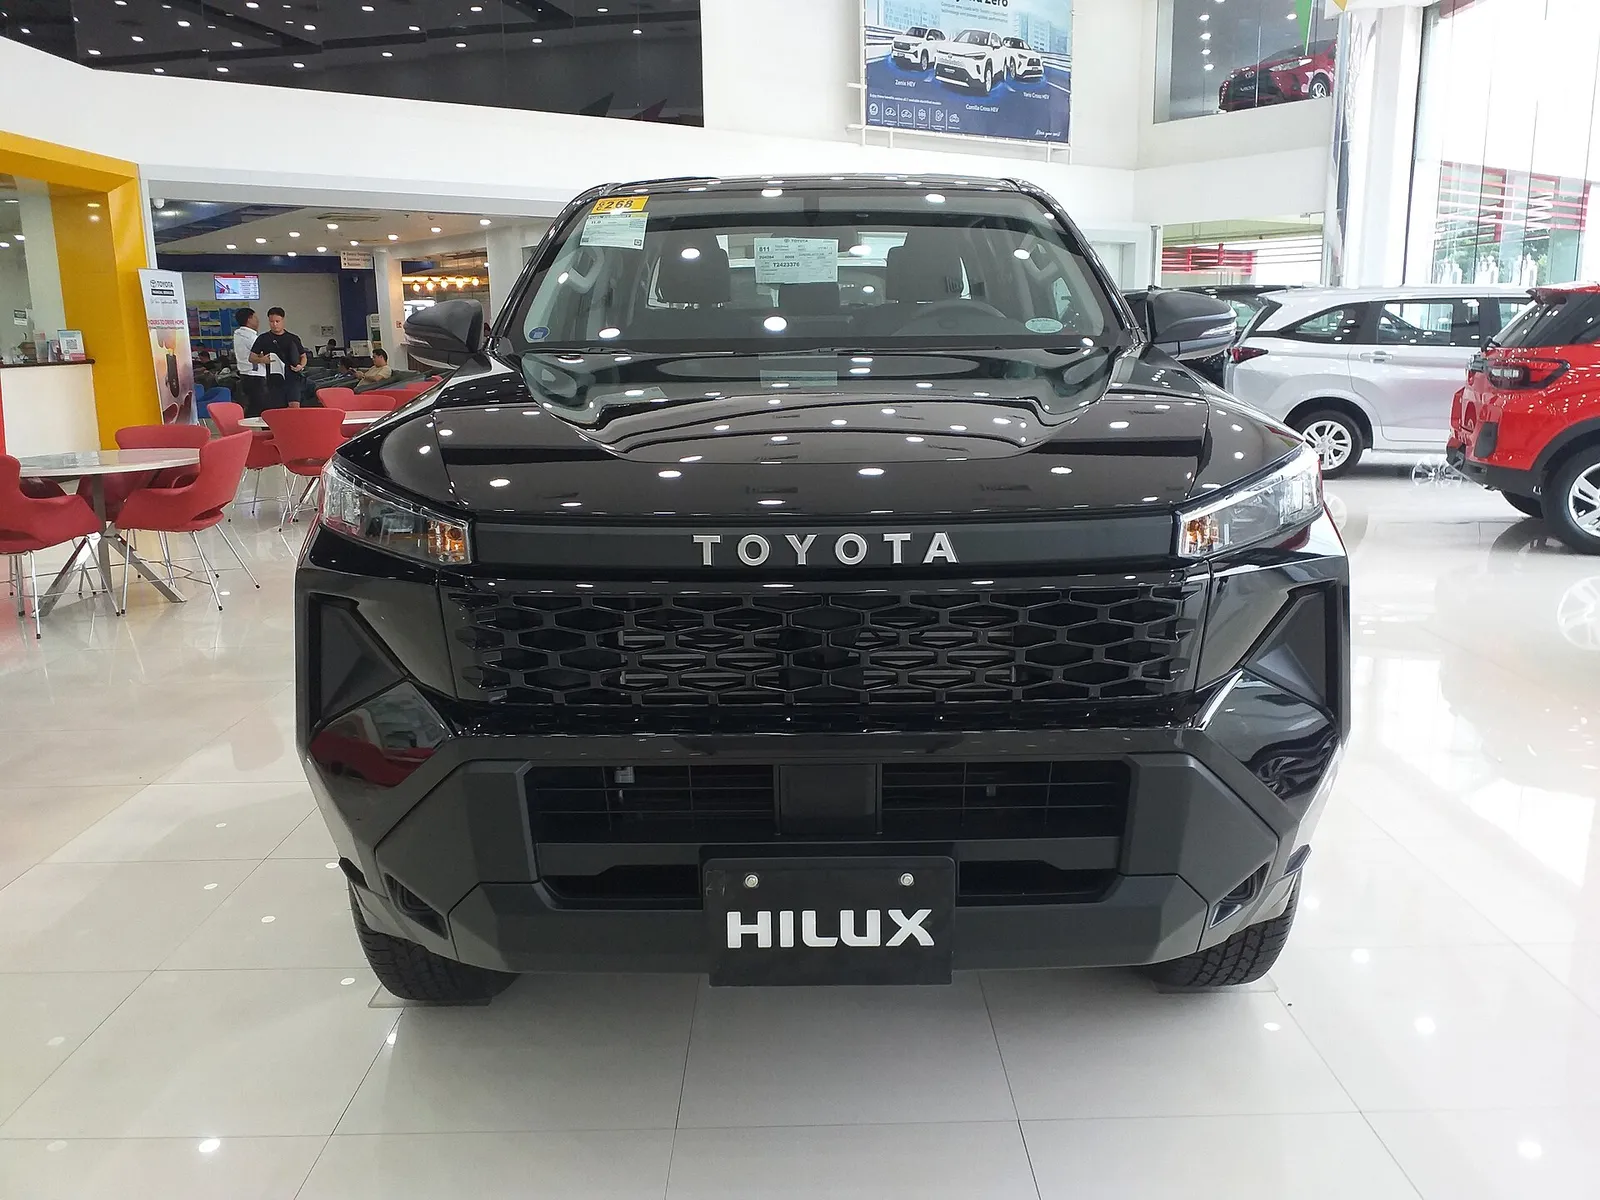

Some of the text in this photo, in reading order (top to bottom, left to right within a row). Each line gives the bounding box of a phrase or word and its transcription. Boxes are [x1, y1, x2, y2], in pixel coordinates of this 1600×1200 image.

[156, 281, 174, 289] TOYOTA
[692, 532, 960, 567] TOYOTA
[726, 909, 935, 949] HILUX
